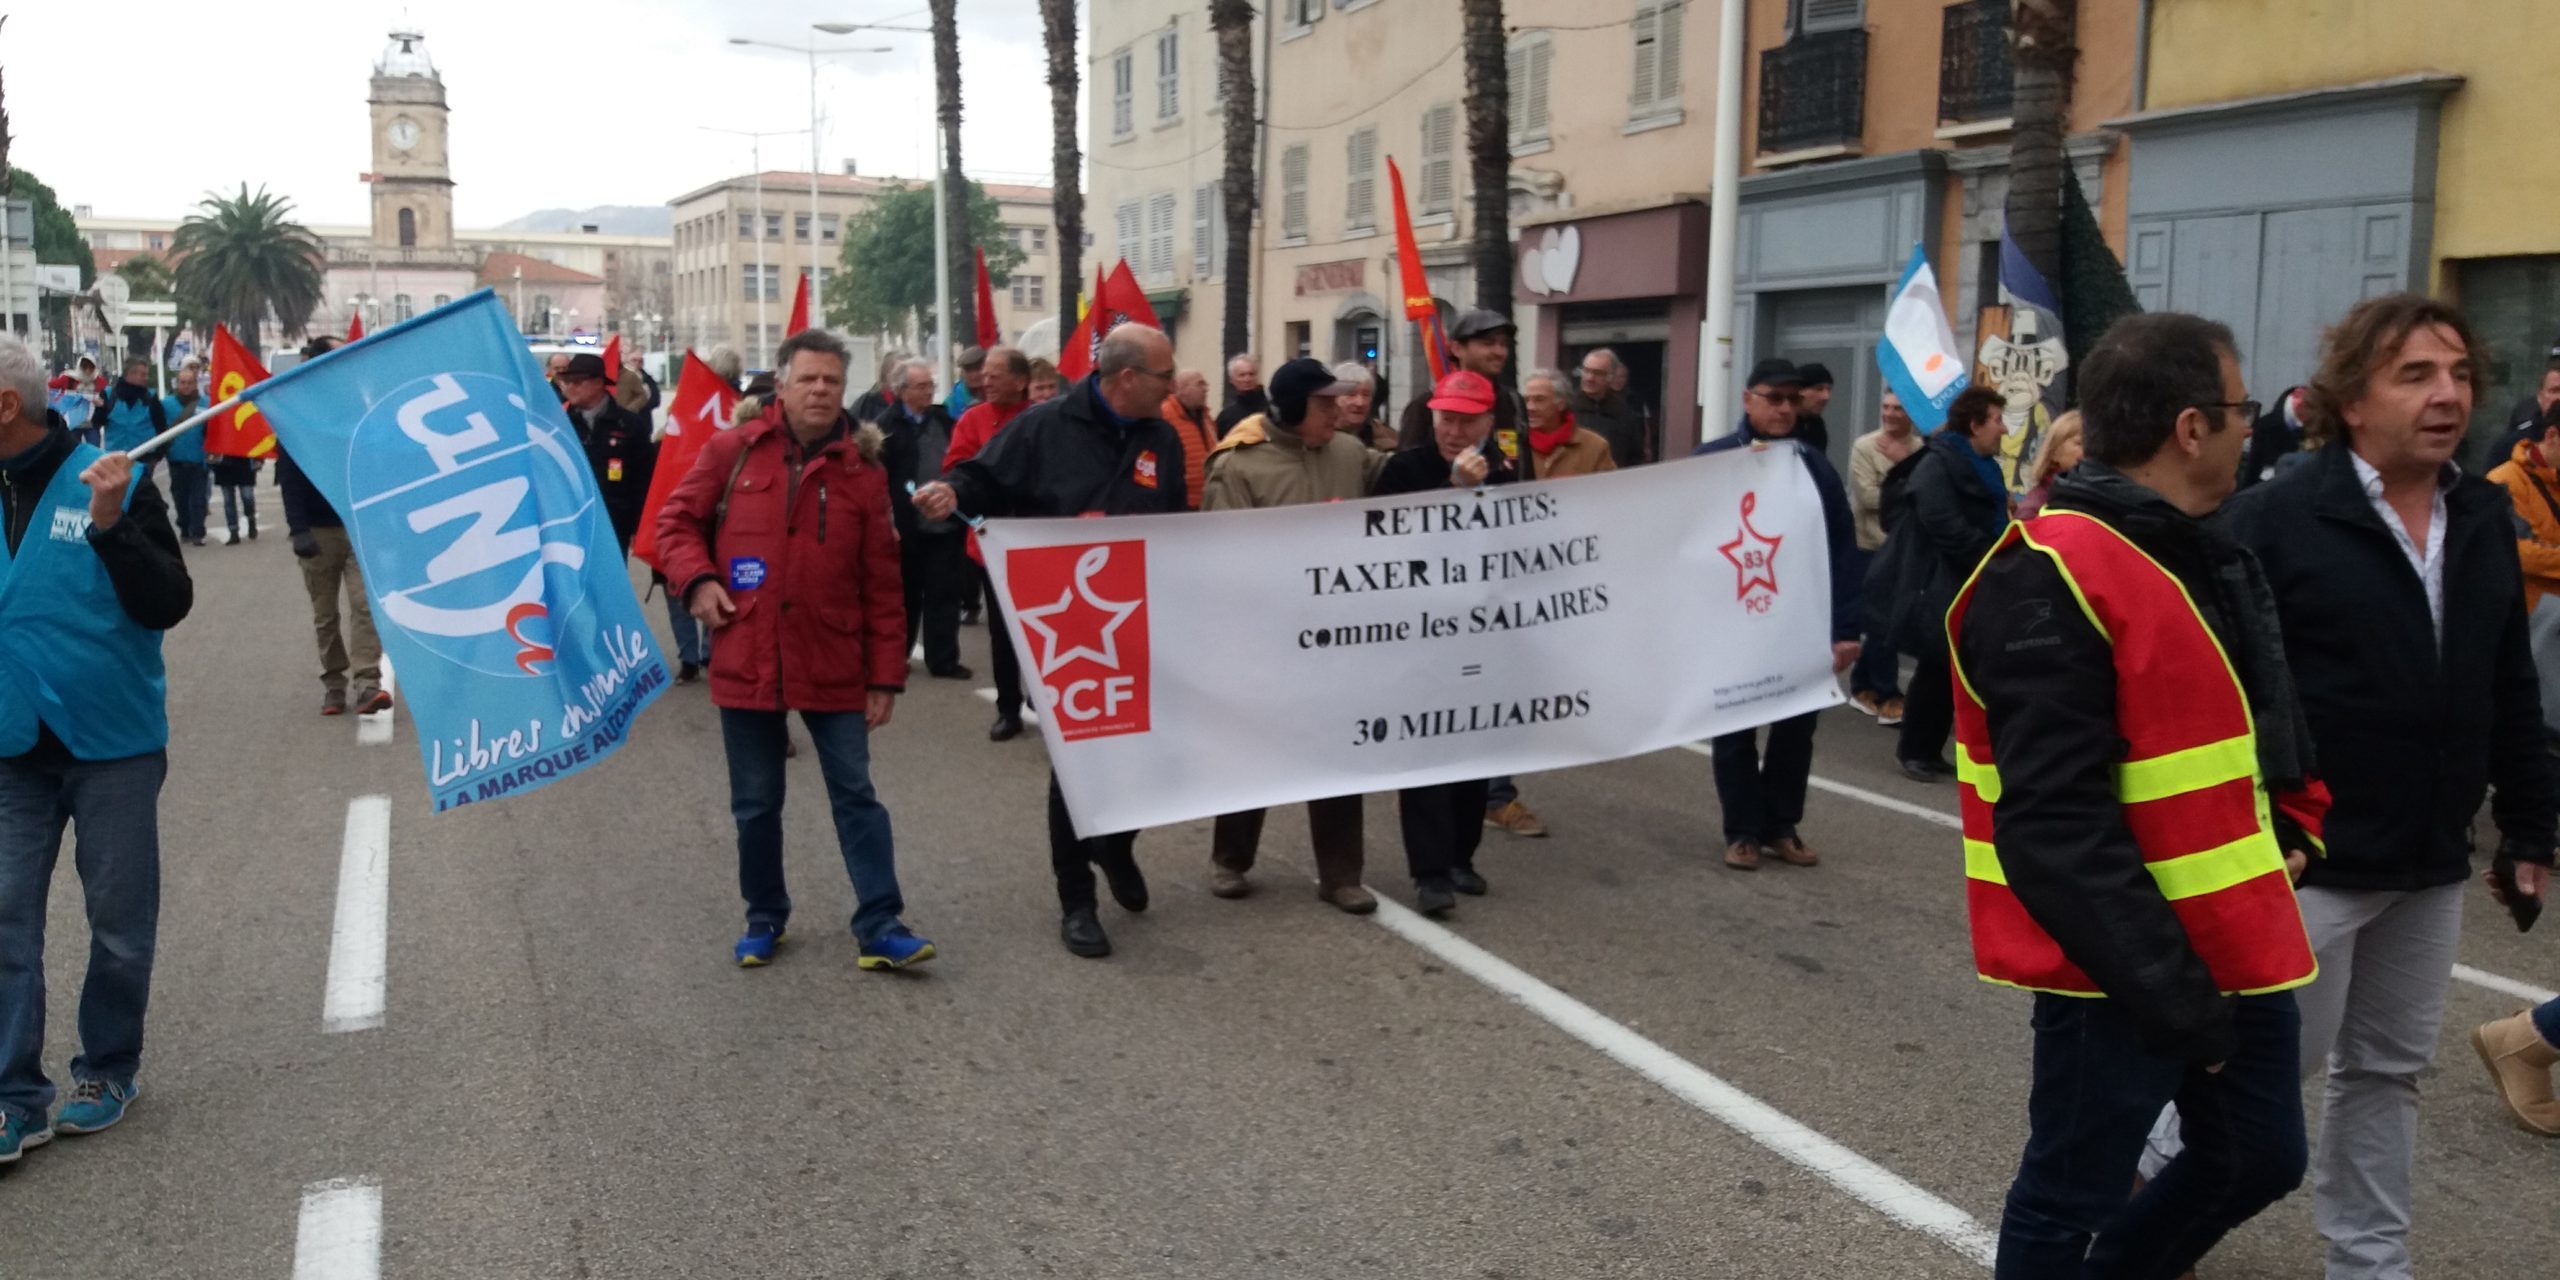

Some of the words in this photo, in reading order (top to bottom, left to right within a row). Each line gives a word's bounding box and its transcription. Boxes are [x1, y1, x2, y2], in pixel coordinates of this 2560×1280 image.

[1364, 492, 1558, 537] RETRAITES:
[1305, 560, 1430, 595] TAXER
[1442, 558, 1467, 584] la
[1481, 535, 1599, 581] FINANCE
[1744, 550, 1764, 569] 83
[1298, 620, 1410, 649] comme
[1420, 612, 1458, 640] les
[1468, 584, 1609, 634] SALAIRES
[1745, 594, 1773, 615] PCF
[1352, 716, 1389, 746] 30
[1399, 689, 1591, 741] MILLIARDS
[432, 718, 542, 786] Libres
[478, 743, 590, 801] MARQUE
